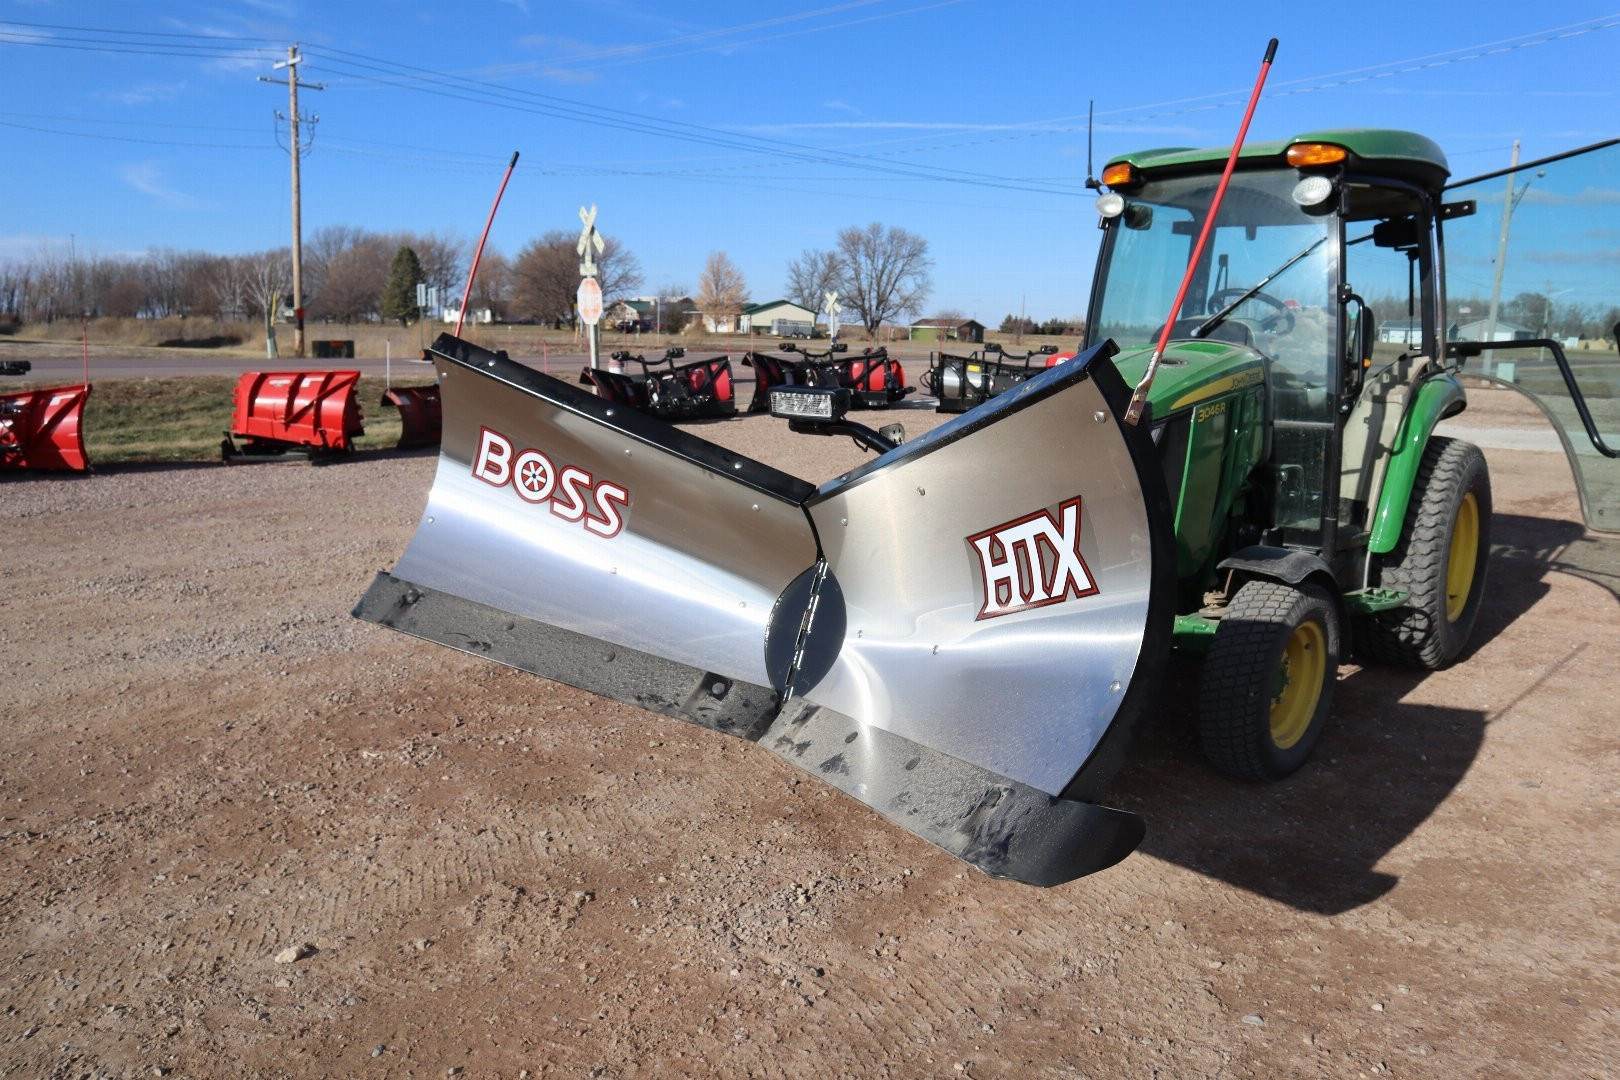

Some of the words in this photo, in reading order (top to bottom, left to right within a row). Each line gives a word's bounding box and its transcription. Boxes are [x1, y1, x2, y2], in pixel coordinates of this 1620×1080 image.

[1198, 402, 1226, 423] 3046R
[472, 426, 628, 539] BOSS
[966, 495, 1100, 621] HTX
